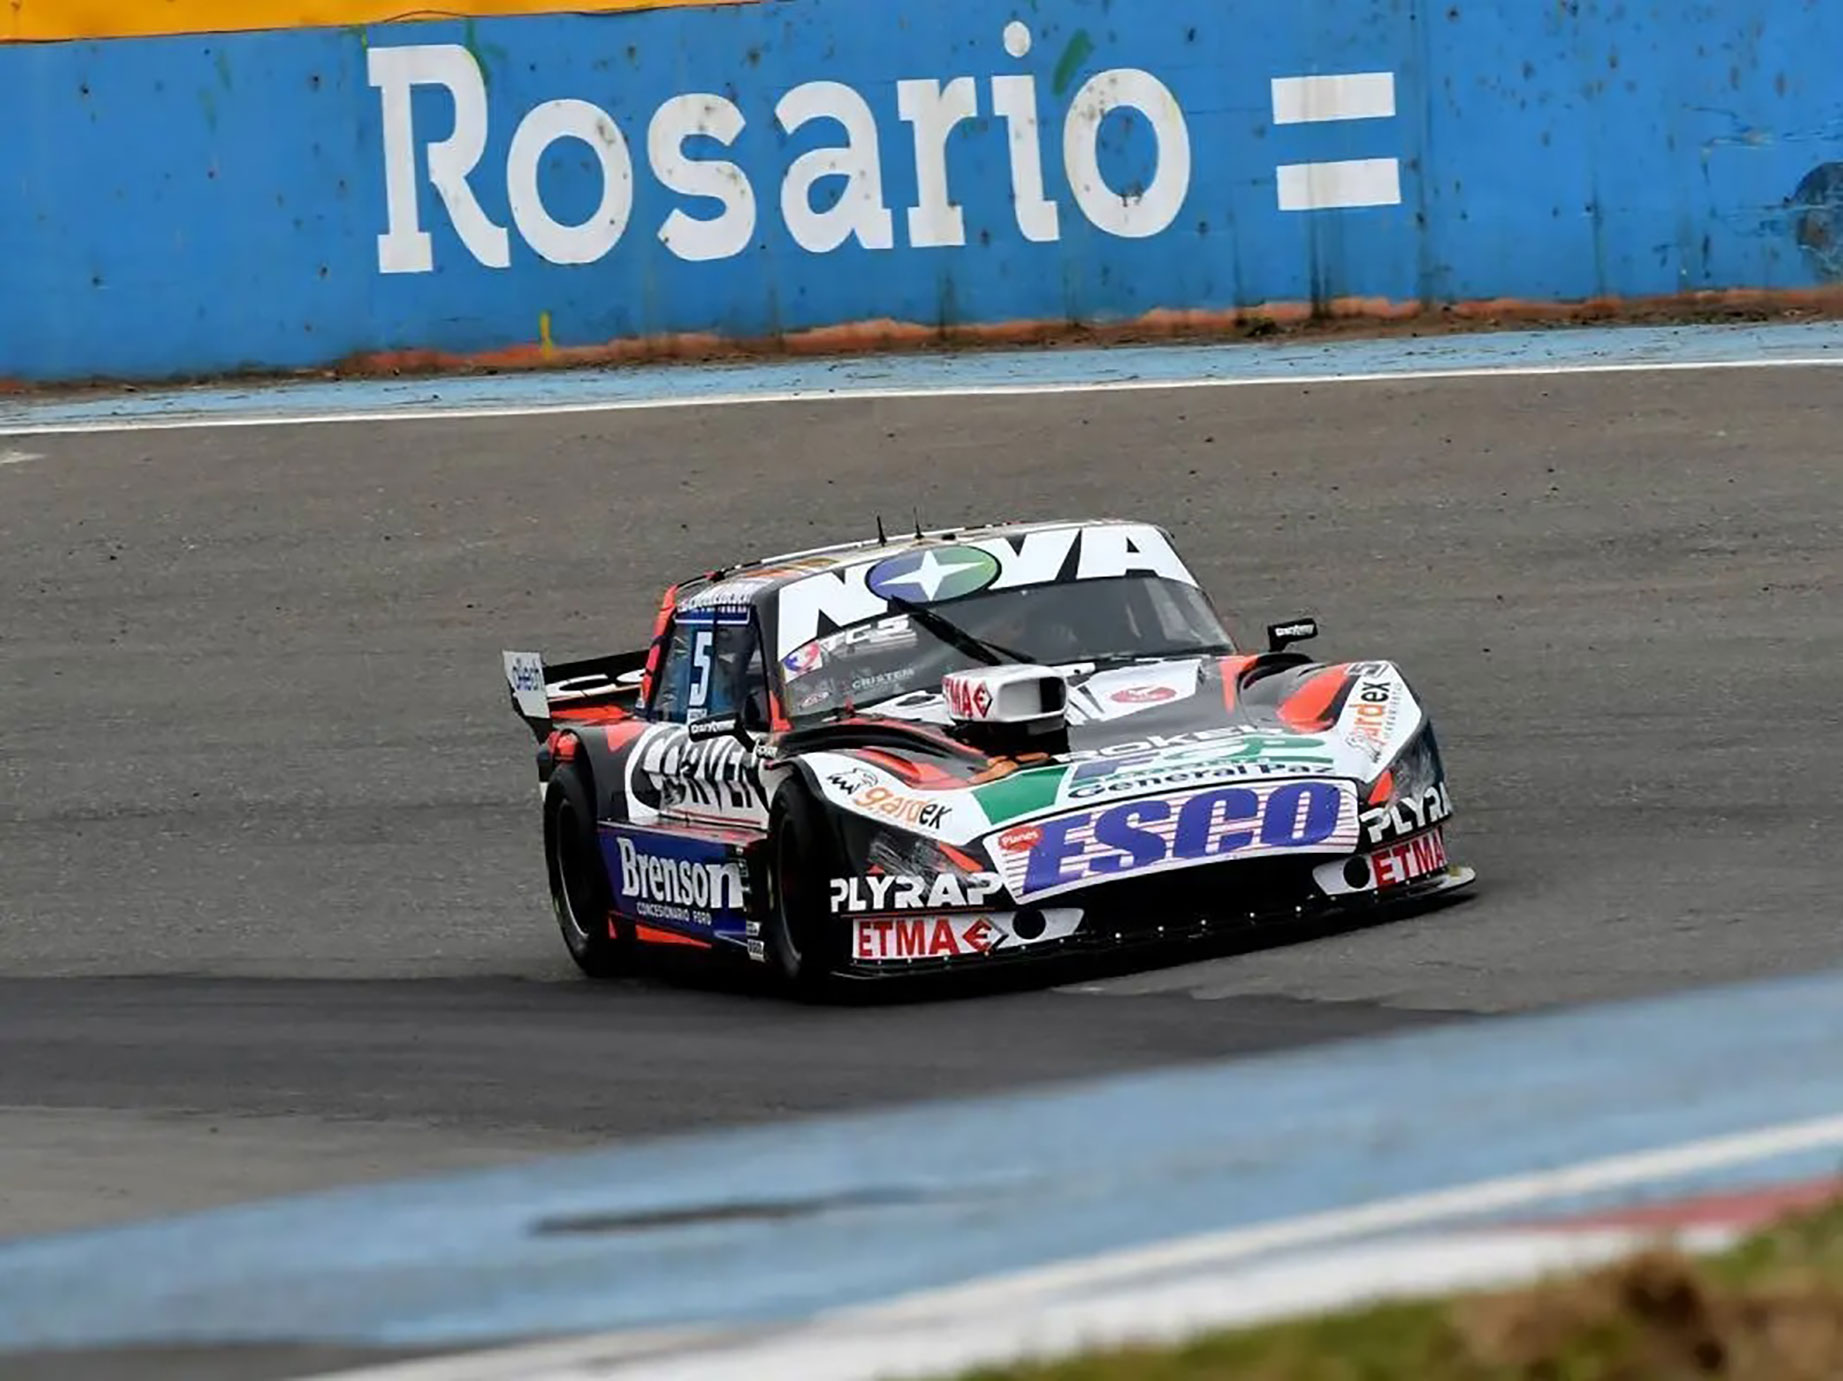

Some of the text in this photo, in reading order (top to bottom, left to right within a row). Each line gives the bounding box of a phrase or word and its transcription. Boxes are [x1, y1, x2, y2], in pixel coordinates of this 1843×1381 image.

[367, 21, 1190, 273] Rosario
[689, 632, 712, 706] 5
[1068, 762, 1333, 798] General Paz
[854, 786, 952, 830] gardex
[1001, 830, 1040, 846] Planes
[1021, 781, 1342, 895] ESCO
[616, 836, 744, 909] Brenson
[830, 872, 1002, 913] PLYRAP
[857, 917, 961, 957] ETMA
